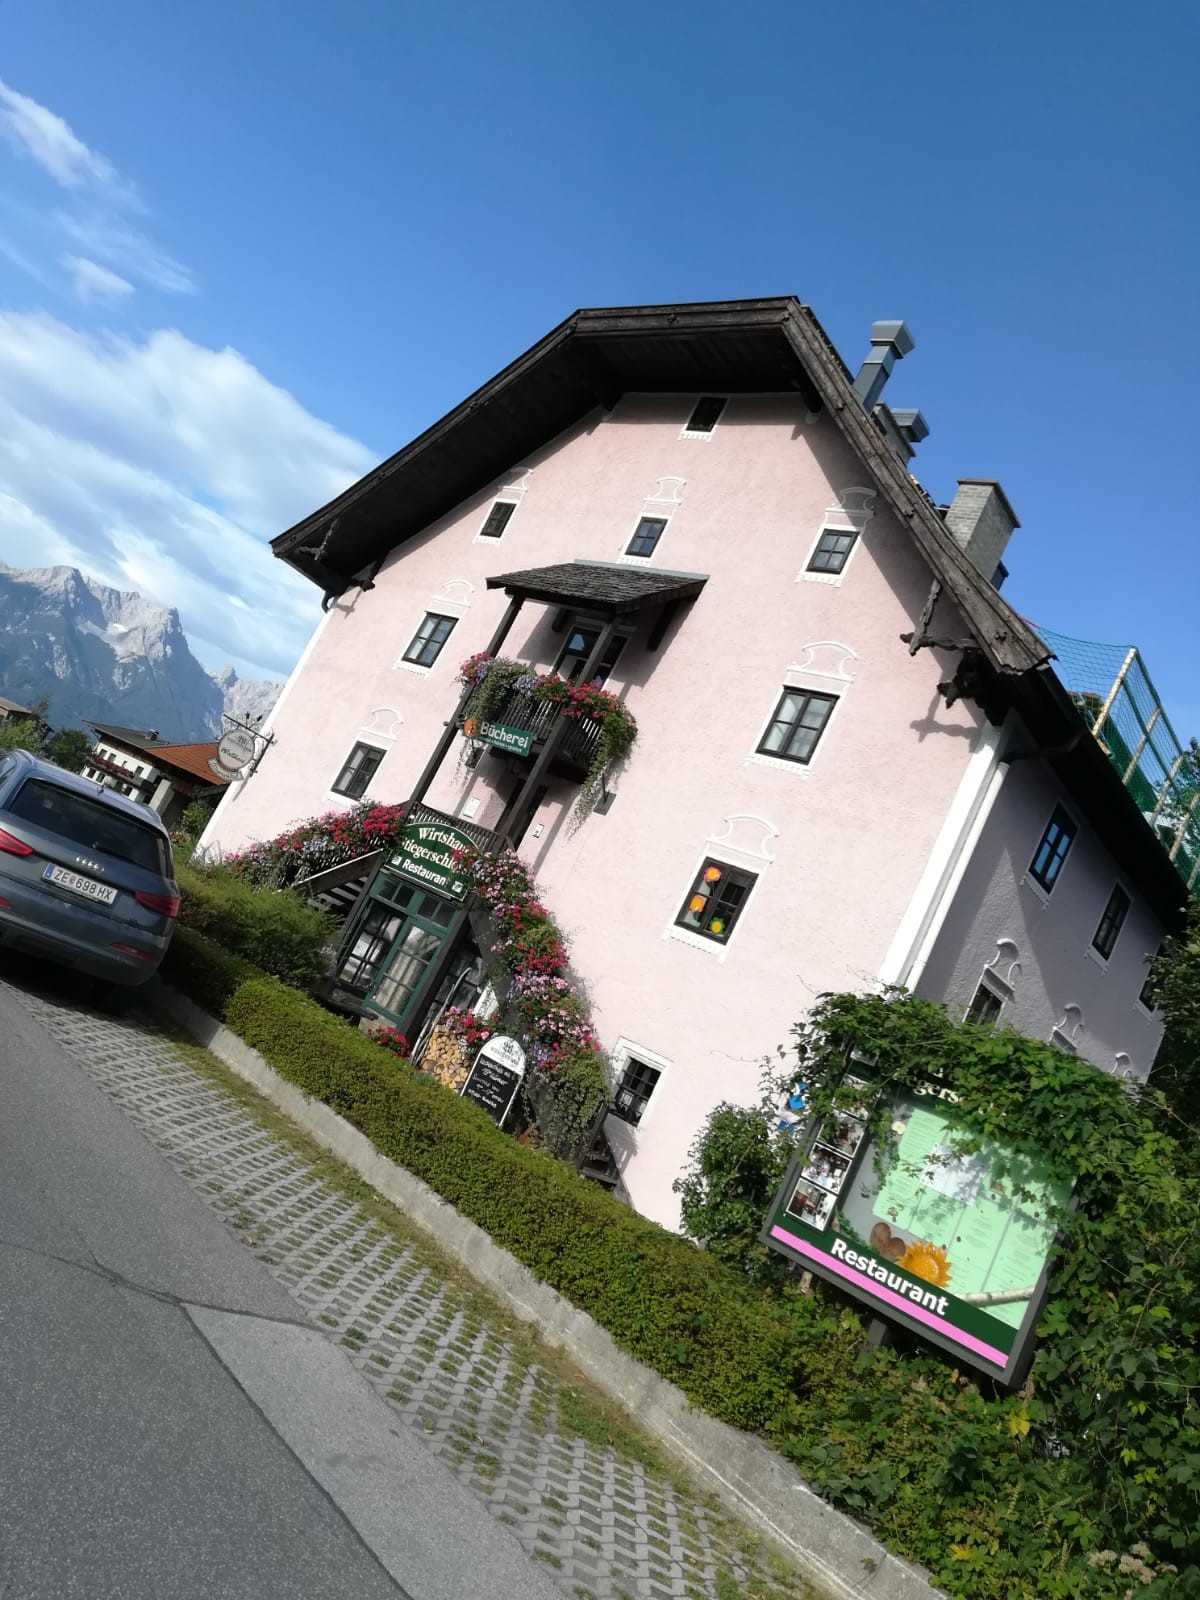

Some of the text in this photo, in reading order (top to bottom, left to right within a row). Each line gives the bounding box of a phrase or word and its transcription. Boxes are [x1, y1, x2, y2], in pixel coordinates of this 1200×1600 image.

[480, 721, 529, 748] Bücherei
[54, 869, 70, 883] ZE
[402, 858, 449, 888] Restauran
[831, 1238, 949, 1316] Restaurant
